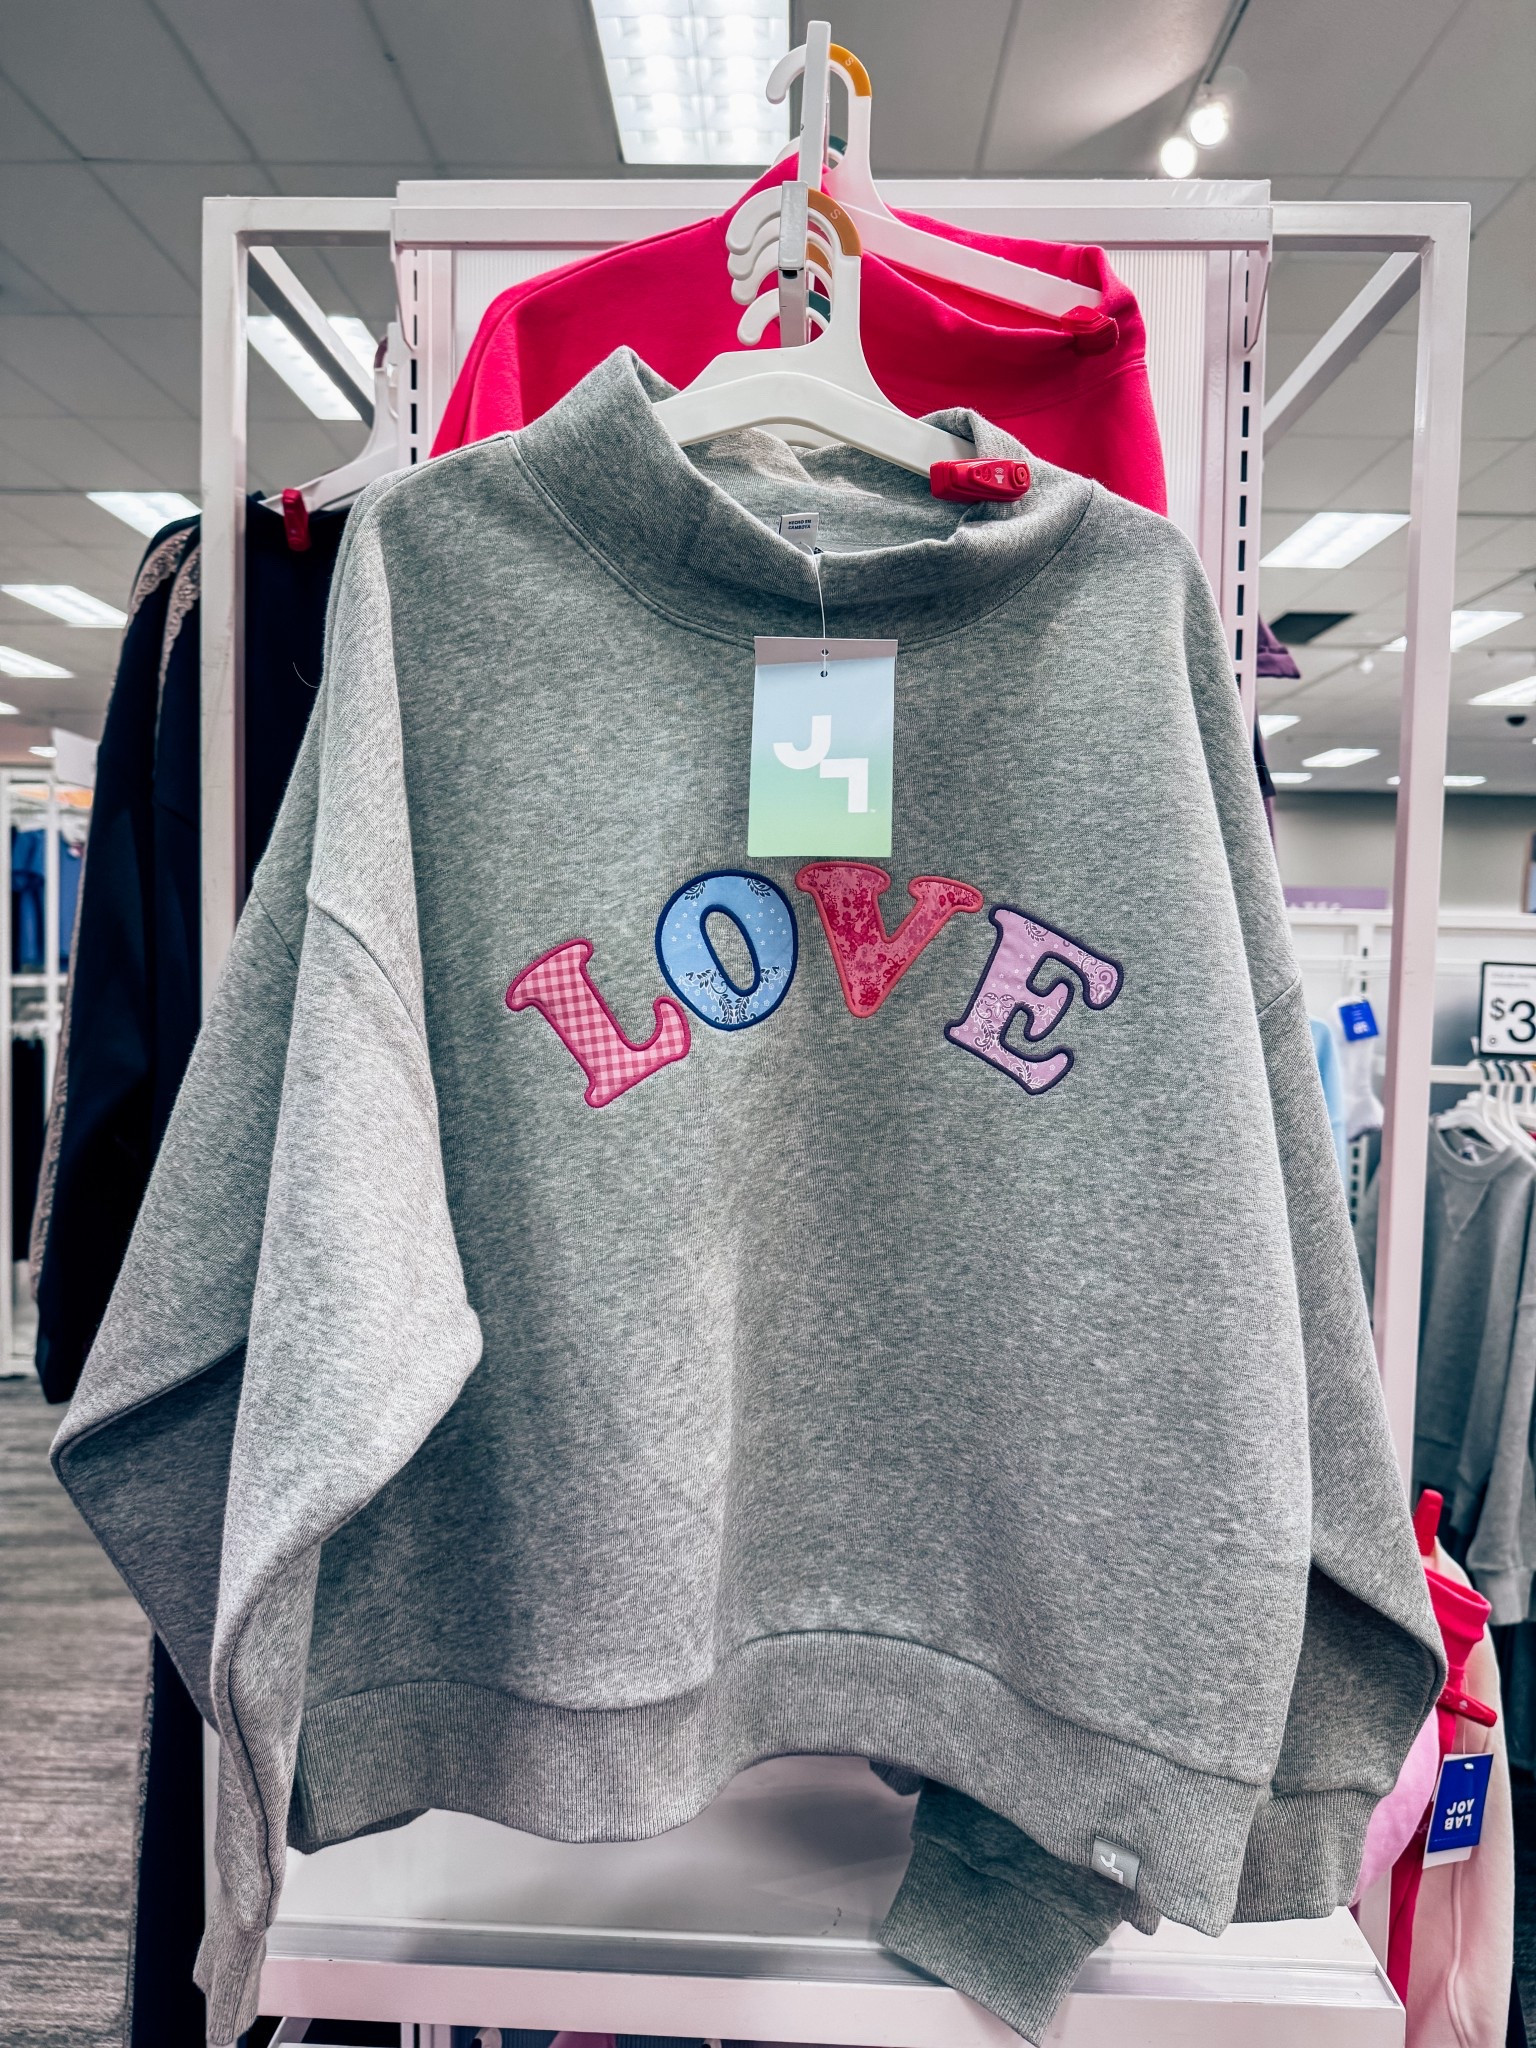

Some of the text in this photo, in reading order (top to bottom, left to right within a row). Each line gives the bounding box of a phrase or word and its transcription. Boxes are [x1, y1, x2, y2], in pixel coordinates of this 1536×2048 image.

[830, 208, 841, 220] S
[505, 862, 1124, 1108] LOVE
[1446, 1798, 1475, 1816] JOY
